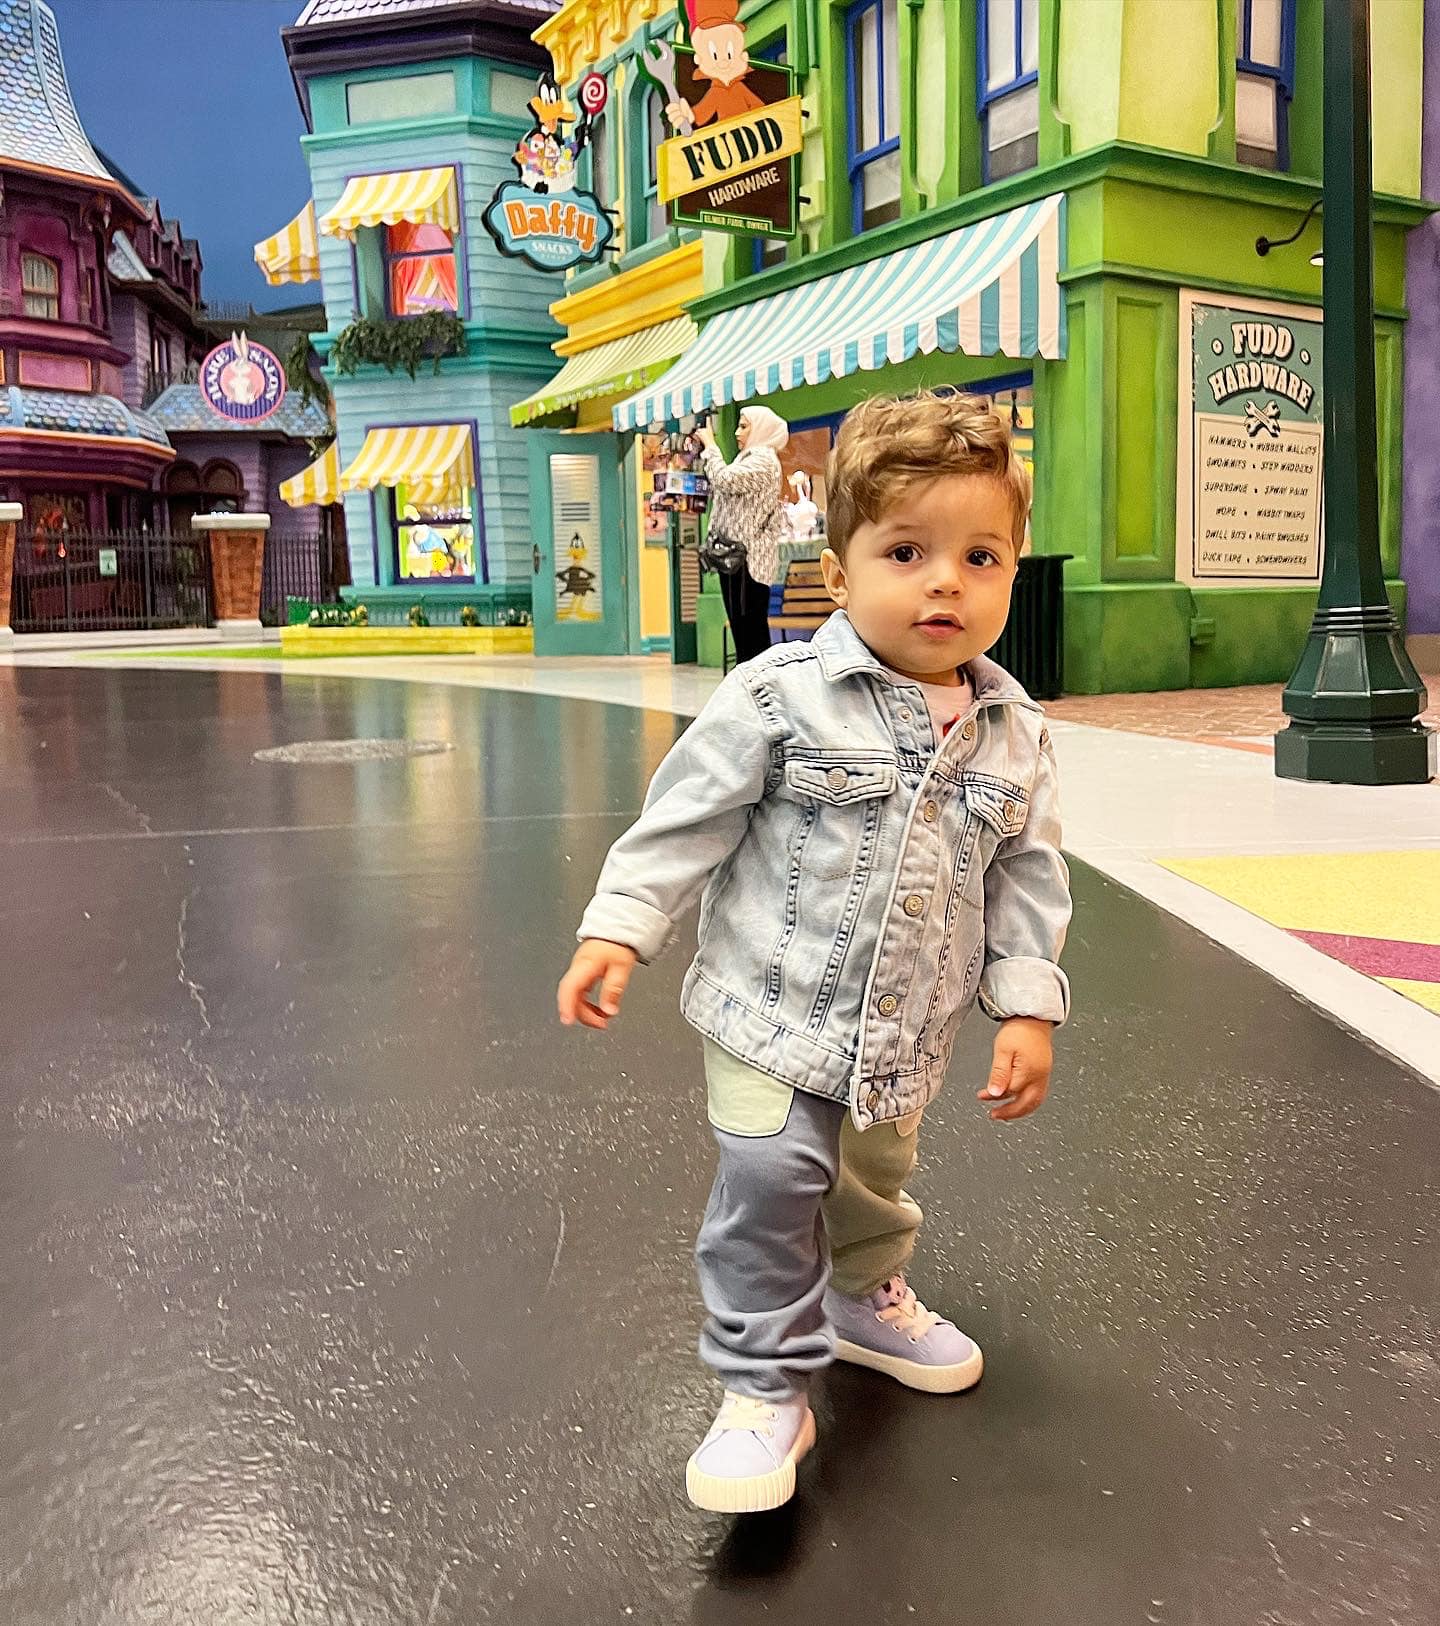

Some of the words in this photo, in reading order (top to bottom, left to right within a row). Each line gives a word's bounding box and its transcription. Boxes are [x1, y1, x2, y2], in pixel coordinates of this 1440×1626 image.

[682, 117, 782, 180] FUDD
[708, 167, 780, 207] HARDWARE
[504, 200, 597, 251] Daffy
[531, 241, 573, 254] SNACKS
[1231, 322, 1293, 360] FUDD
[249, 350, 279, 401] SALON
[1208, 361, 1314, 414] HARDWARE
[1208, 435, 1247, 449] HAMMERS
[1231, 530, 1246, 540] BITS
[1202, 551, 1221, 562] DUCK
[1224, 552, 1242, 563] TAPE
